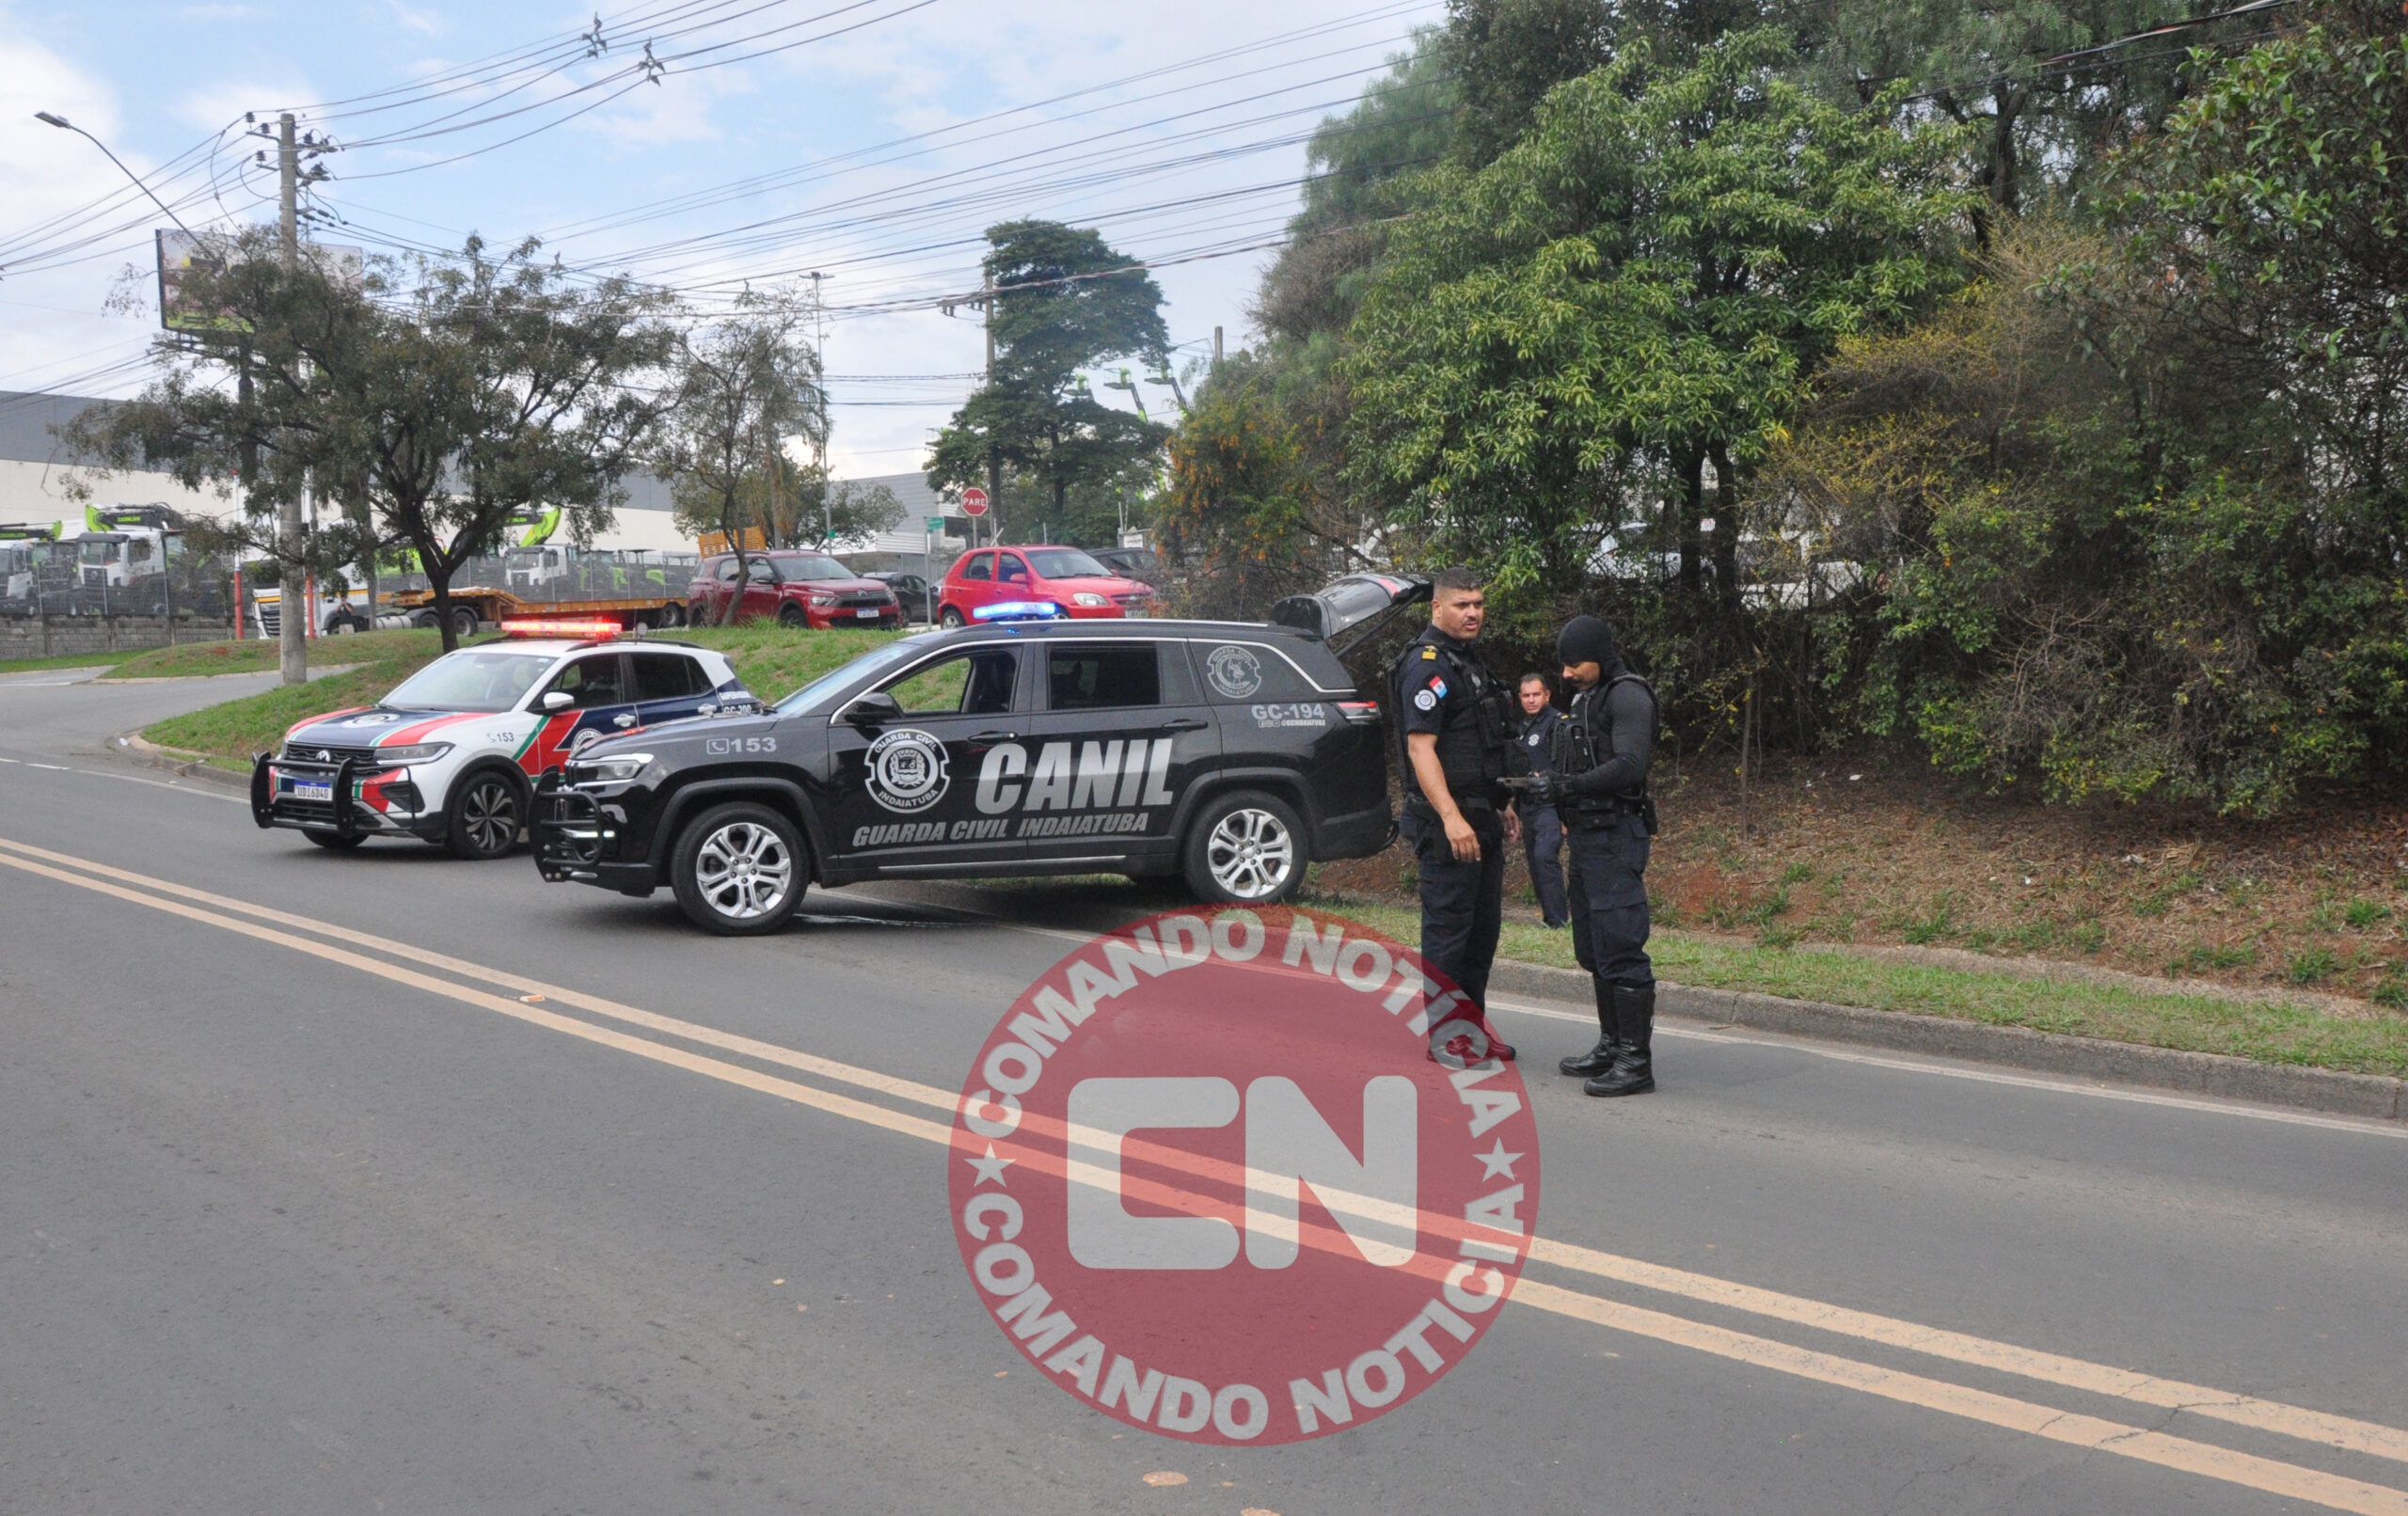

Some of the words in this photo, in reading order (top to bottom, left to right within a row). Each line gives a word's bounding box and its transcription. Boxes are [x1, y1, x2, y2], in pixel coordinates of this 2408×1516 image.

[963, 497, 987, 507] PARE
[1251, 703, 1325, 720] GC-194
[497, 733, 515, 743] 153
[731, 736, 777, 753] 153
[874, 733, 911, 753] GUARDA
[916, 734, 938, 752] CIVIL
[974, 738, 1174, 814] CANIL
[878, 789, 939, 808] INDAIATUBA
[852, 822, 944, 846] GUARDA
[949, 818, 1007, 841] CIVIL
[1017, 813, 1149, 838] INDAIATUBA
